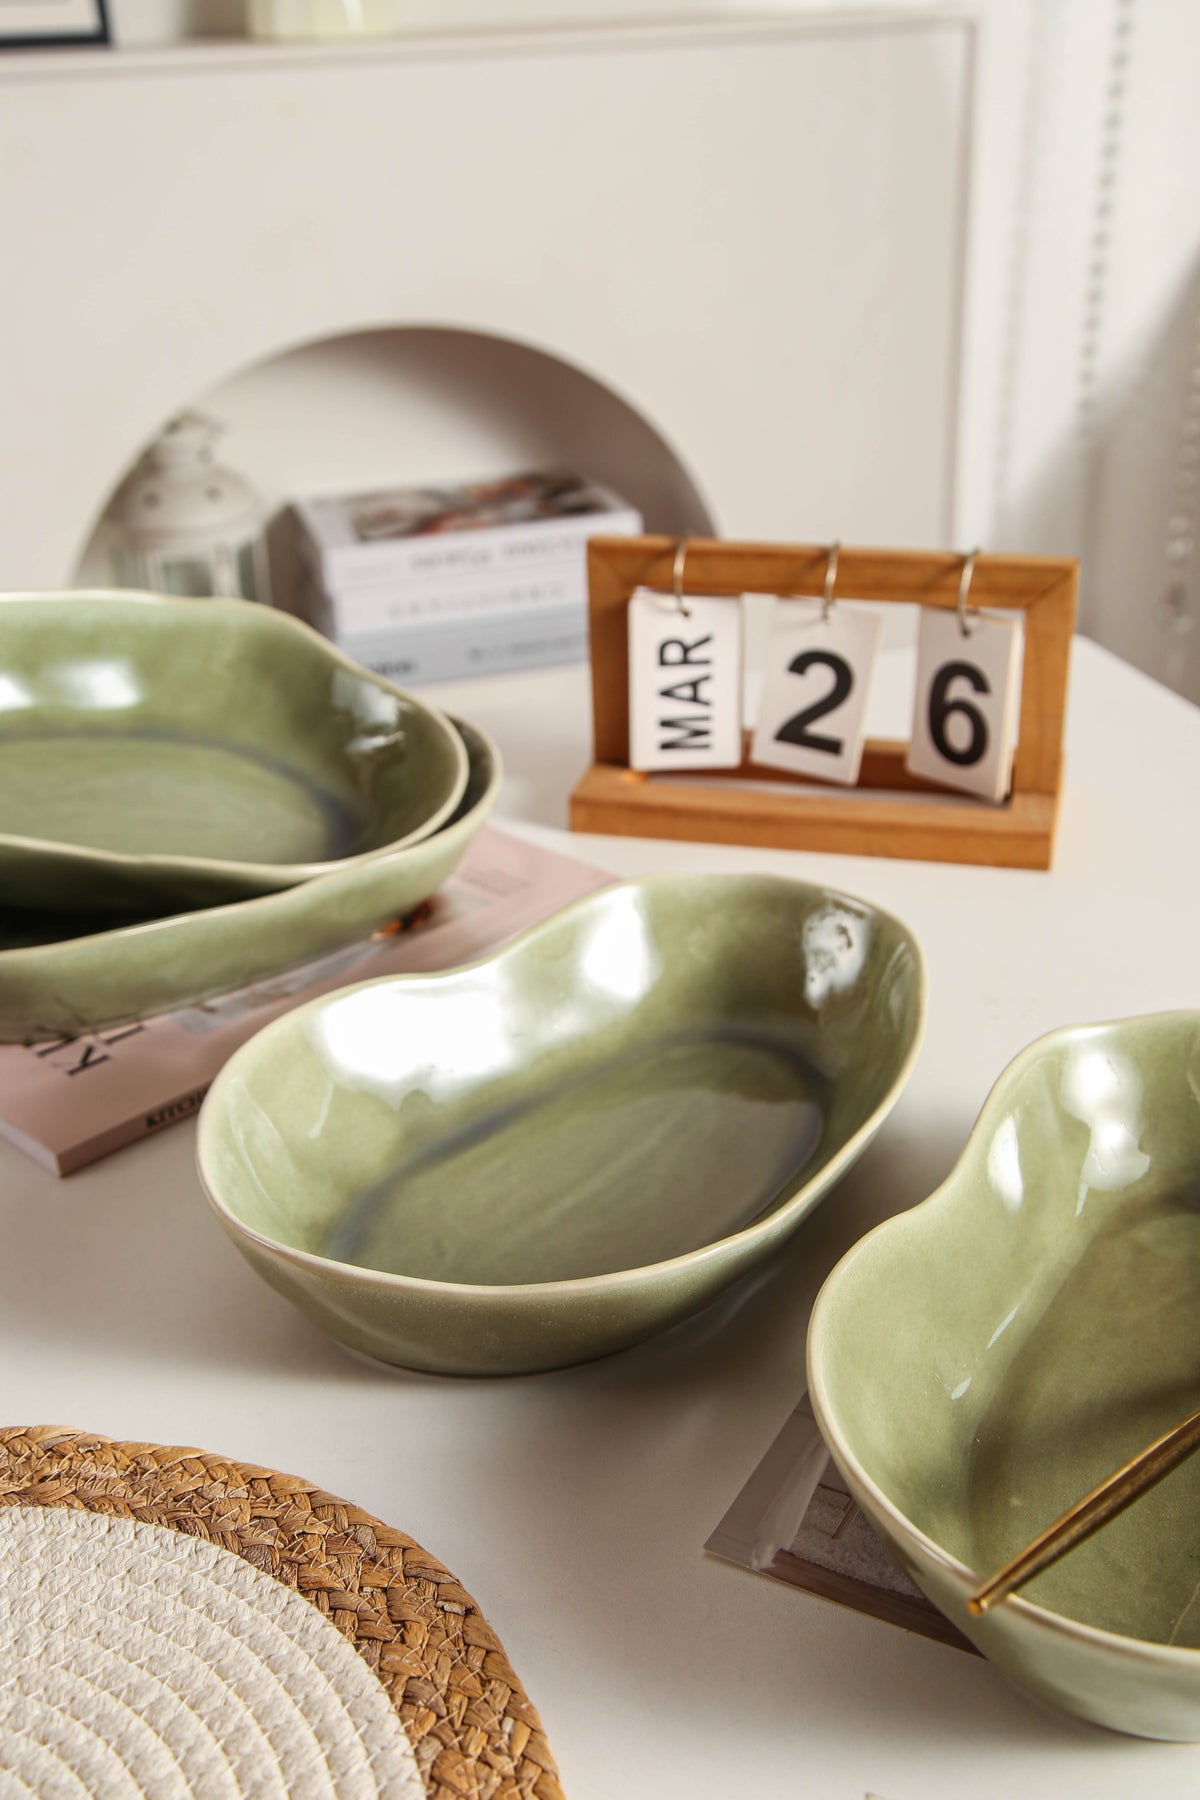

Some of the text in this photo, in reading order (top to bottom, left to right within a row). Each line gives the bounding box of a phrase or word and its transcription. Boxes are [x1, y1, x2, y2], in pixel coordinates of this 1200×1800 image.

[658, 632, 992, 769] MAR 2 6
